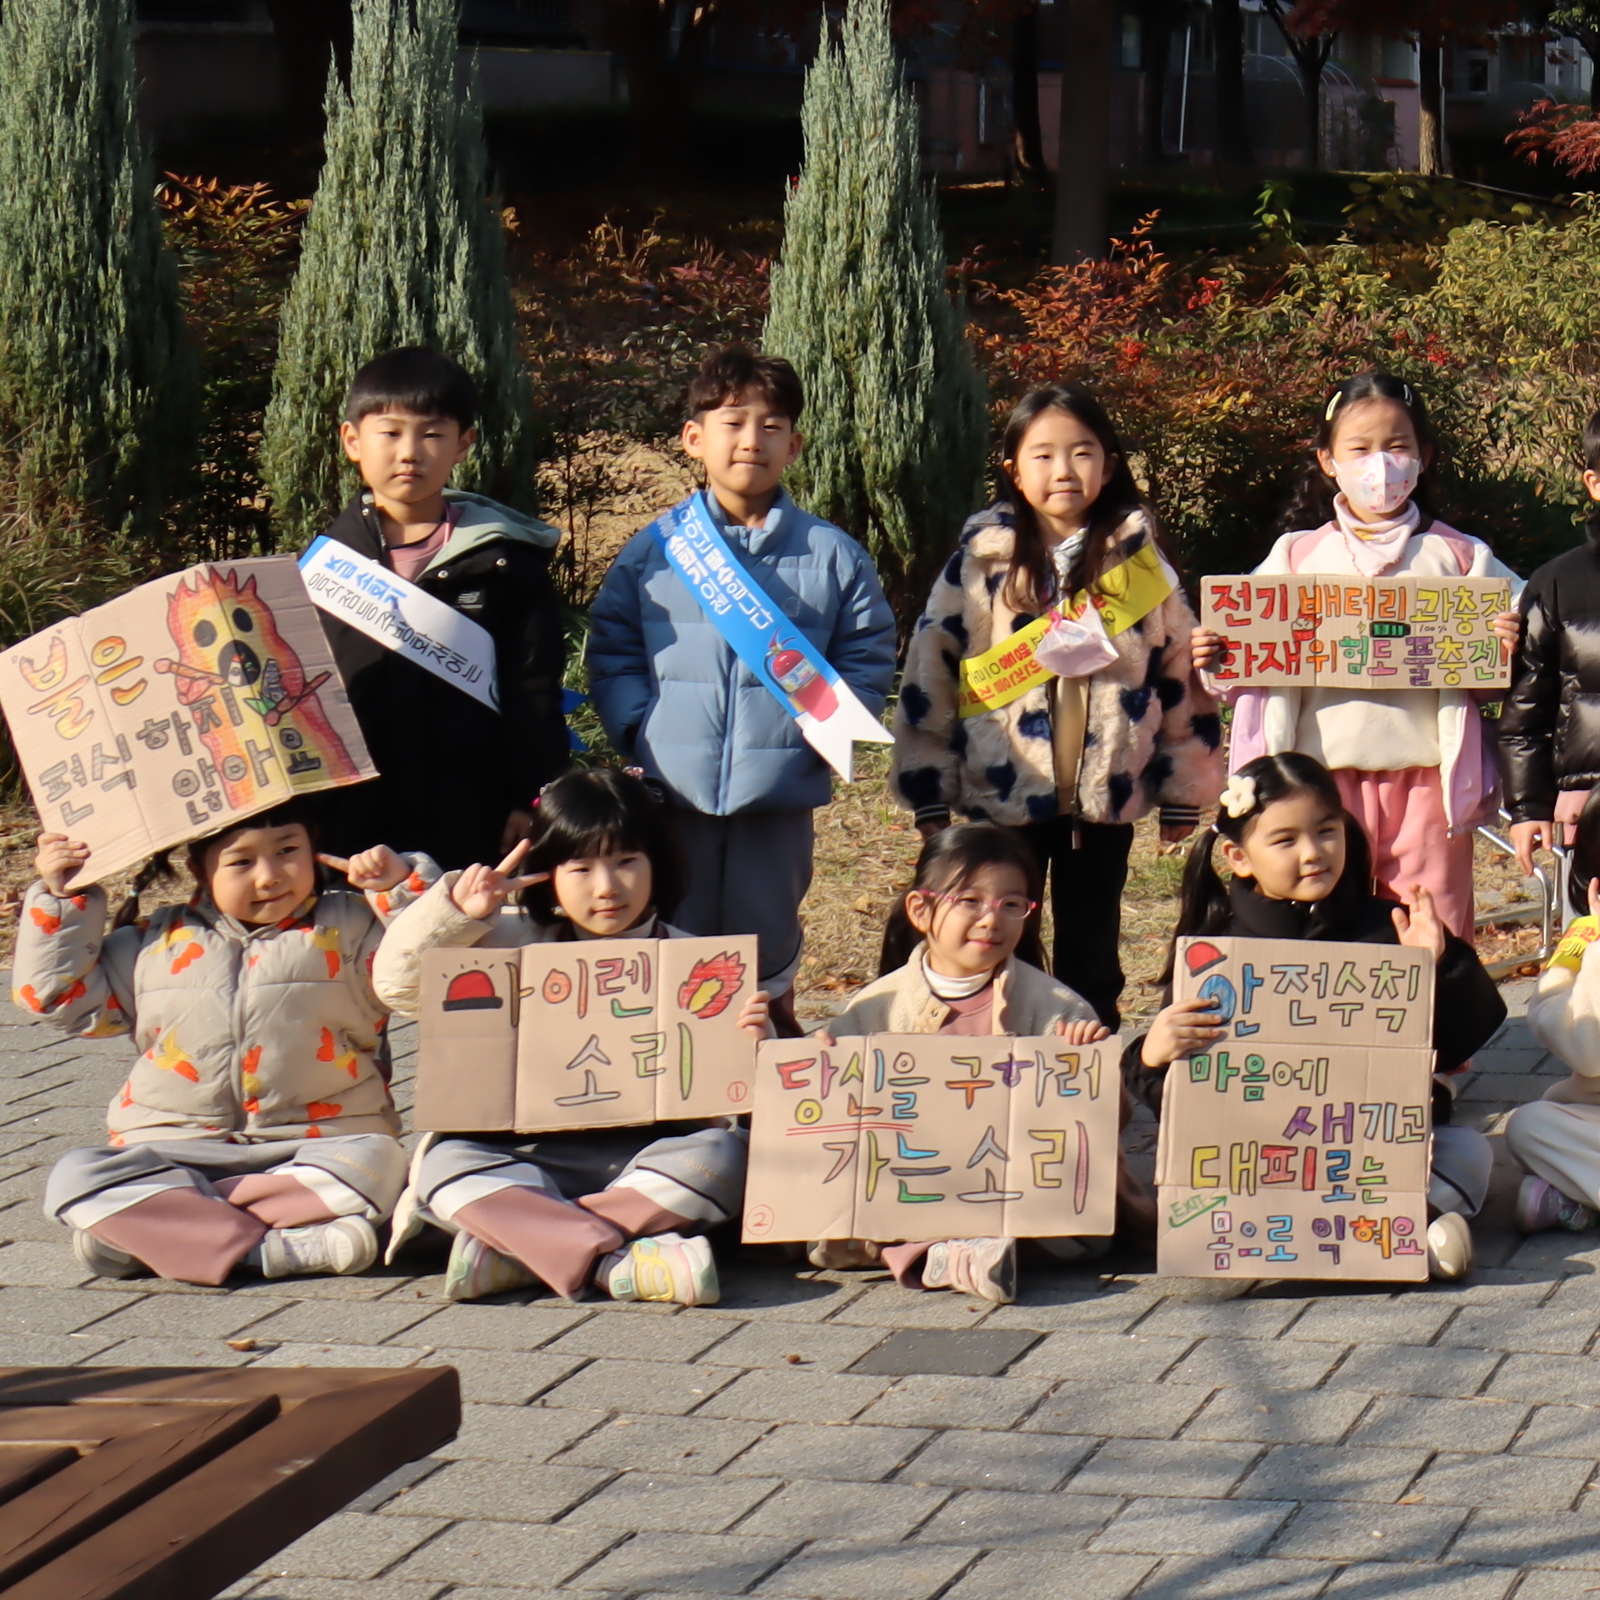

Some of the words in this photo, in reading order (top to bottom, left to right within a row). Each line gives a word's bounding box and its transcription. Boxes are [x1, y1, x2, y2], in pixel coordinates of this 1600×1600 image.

[324, 554, 357, 579] K급
[356, 572, 407, 612] 소화기
[668, 534, 709, 584] 소화기
[700, 577, 732, 615] 이젠
[684, 518, 714, 553] 아닌
[703, 547, 774, 630] 필수입니다
[1210, 581, 1289, 627] 전기
[1298, 584, 1408, 621] 배터리
[172, 727, 321, 824] 않아요
[554, 1022, 693, 1106] 소리
[776, 1049, 930, 1125] 당신을
[945, 1048, 1102, 1109] 구하러
[1189, 1051, 1330, 1102] 마음에
[1281, 1102, 1426, 1144] 새기고
[822, 1130, 952, 1202] 가는
[956, 1120, 1090, 1215] 소리
[1190, 1140, 1388, 1204] 대피로는
[1207, 1211, 1298, 1270] 몸으로
